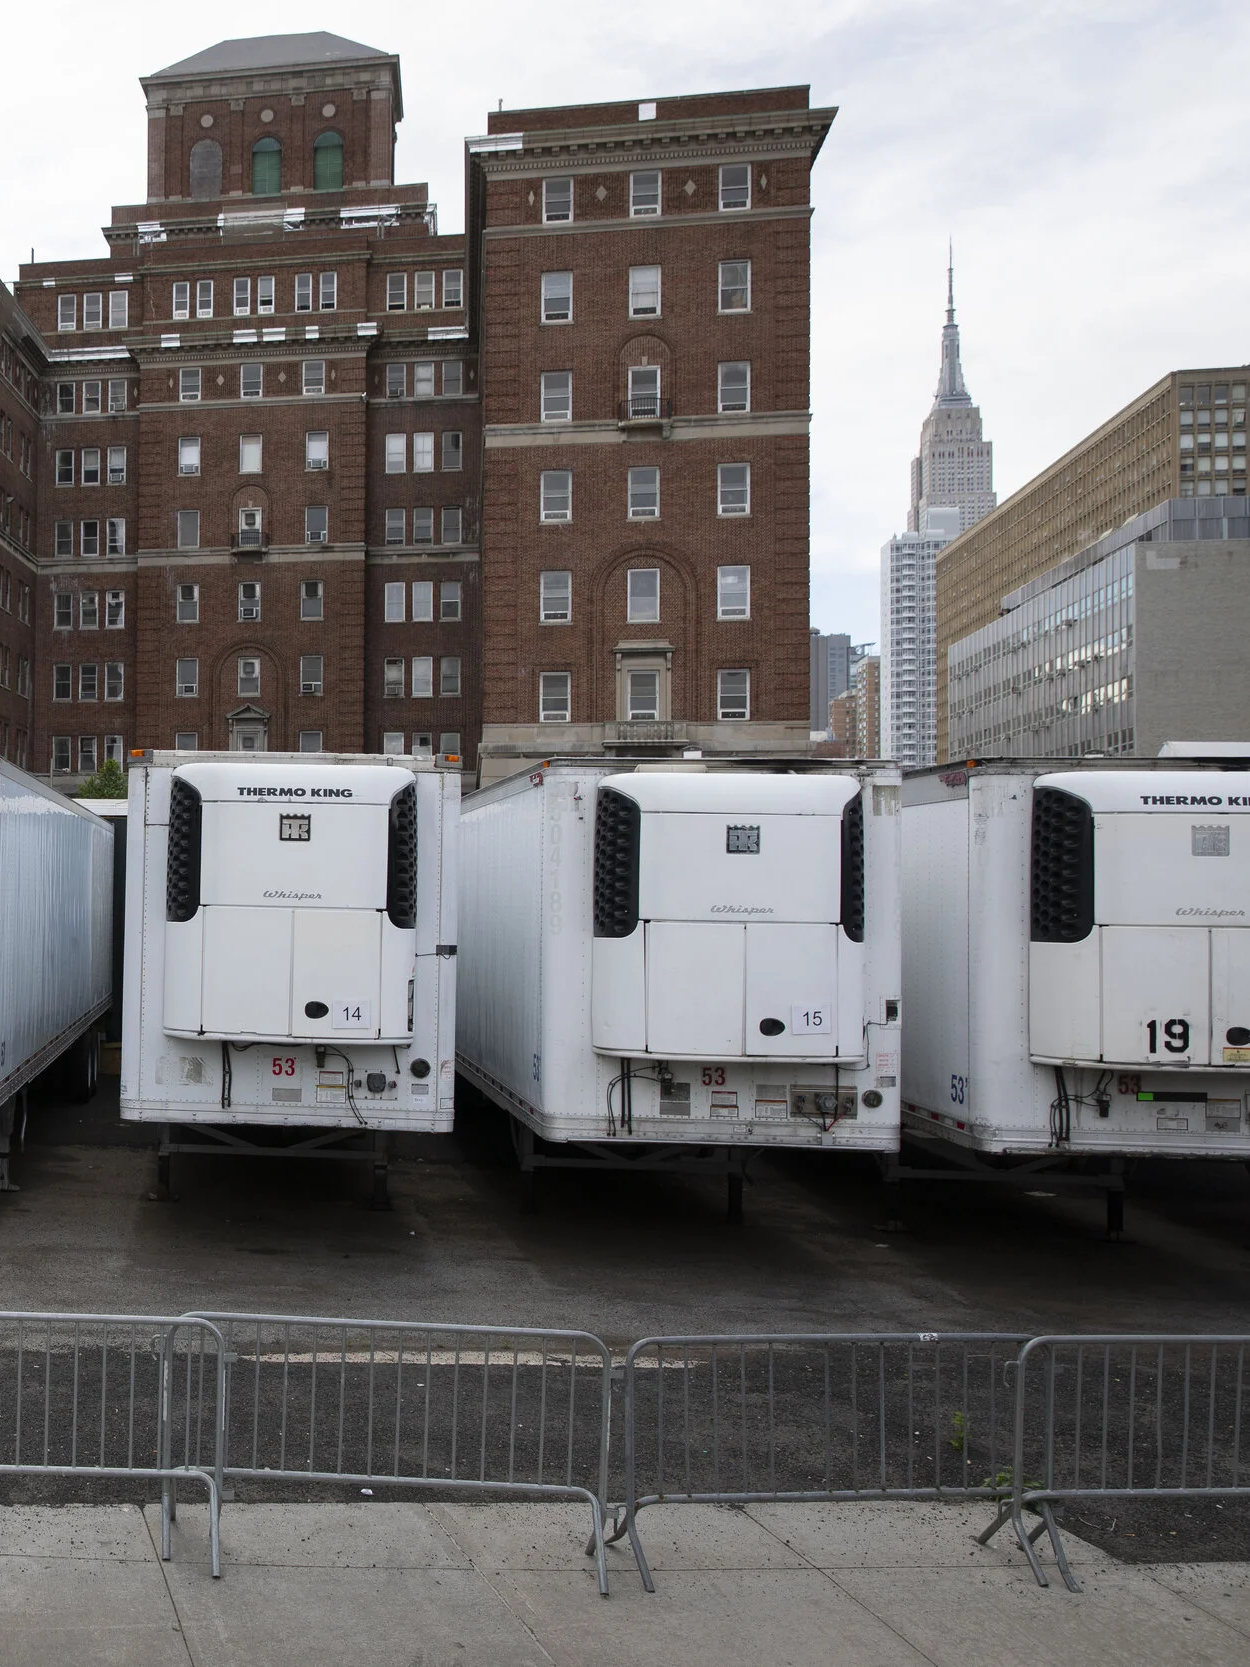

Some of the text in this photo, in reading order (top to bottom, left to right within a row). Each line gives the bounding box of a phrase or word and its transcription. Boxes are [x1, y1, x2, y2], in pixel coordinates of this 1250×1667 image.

[237, 787, 353, 798] THERMO KING
[1140, 795, 1250, 806] THERMO KI
[263, 890, 322, 901] Whisper
[710, 904, 774, 915] Whisper
[1175, 906, 1245, 917] Whisper
[342, 1006, 362, 1021] 14
[802, 1011, 823, 1027] 15
[1146, 1018, 1190, 1053] 19
[272, 1057, 295, 1076] 53
[702, 1066, 726, 1086] 53
[1117, 1074, 1141, 1095] 53
